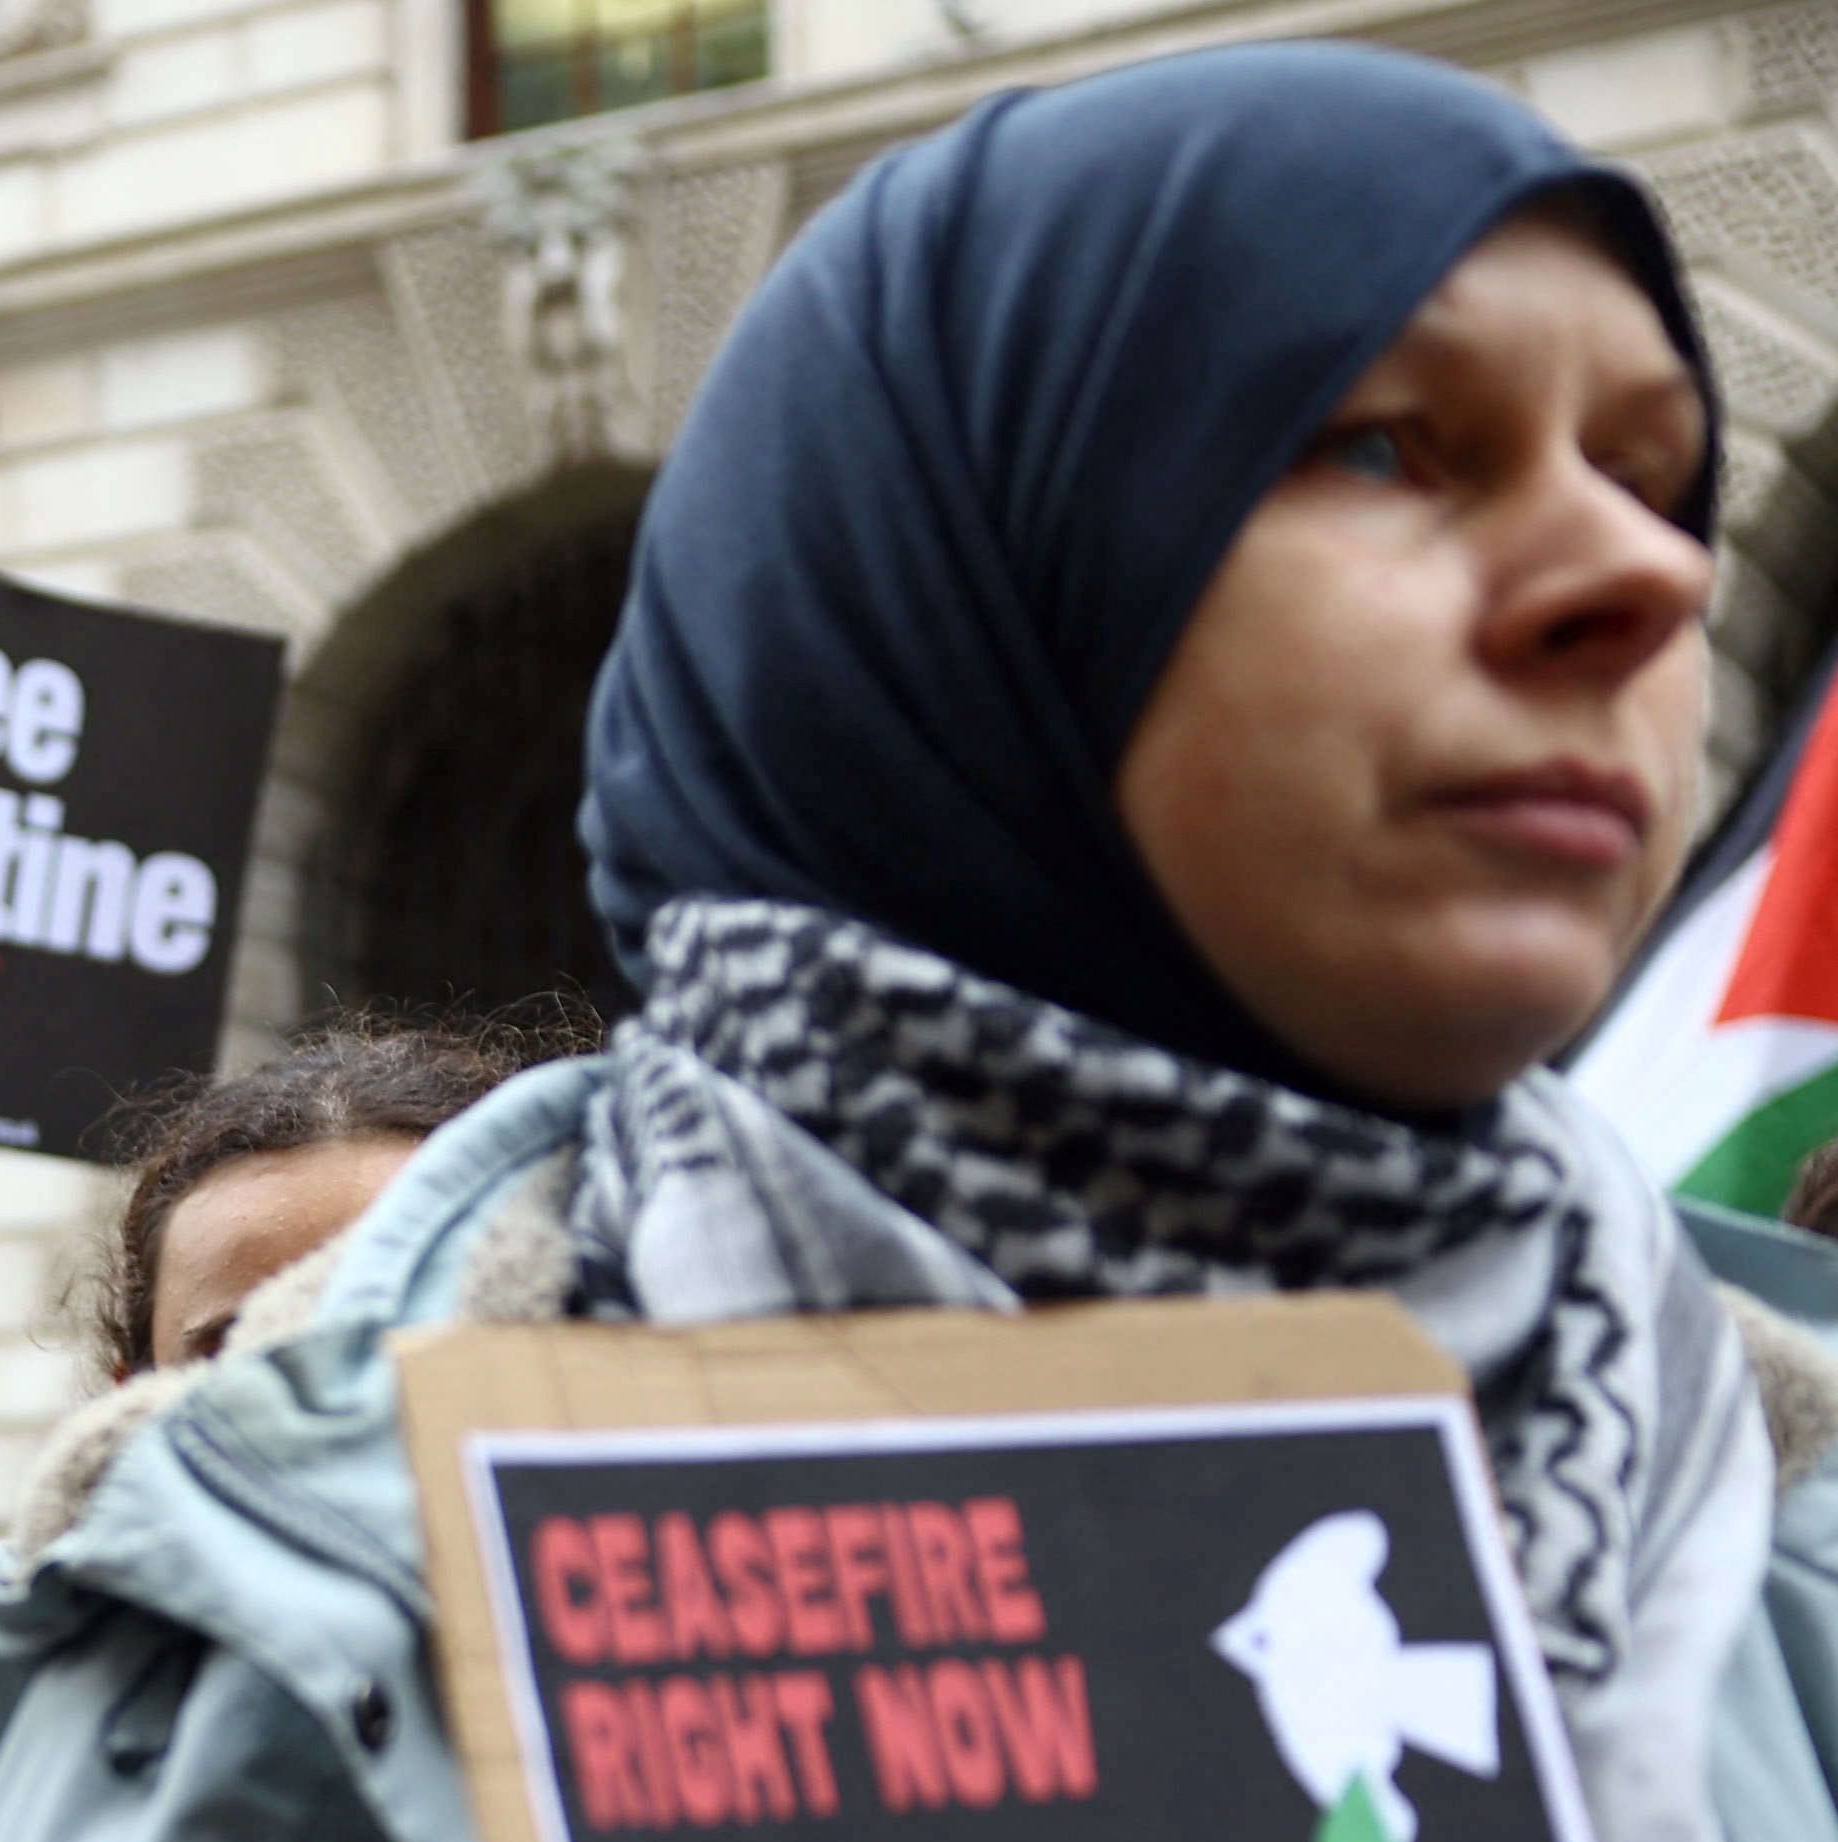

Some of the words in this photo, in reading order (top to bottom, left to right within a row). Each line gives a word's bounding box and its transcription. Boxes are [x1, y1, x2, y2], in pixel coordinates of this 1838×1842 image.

[534, 1497, 1046, 1662] CEASEFIRE
[559, 1671, 843, 1830] RIGHT
[856, 1656, 1099, 1808] NOW
